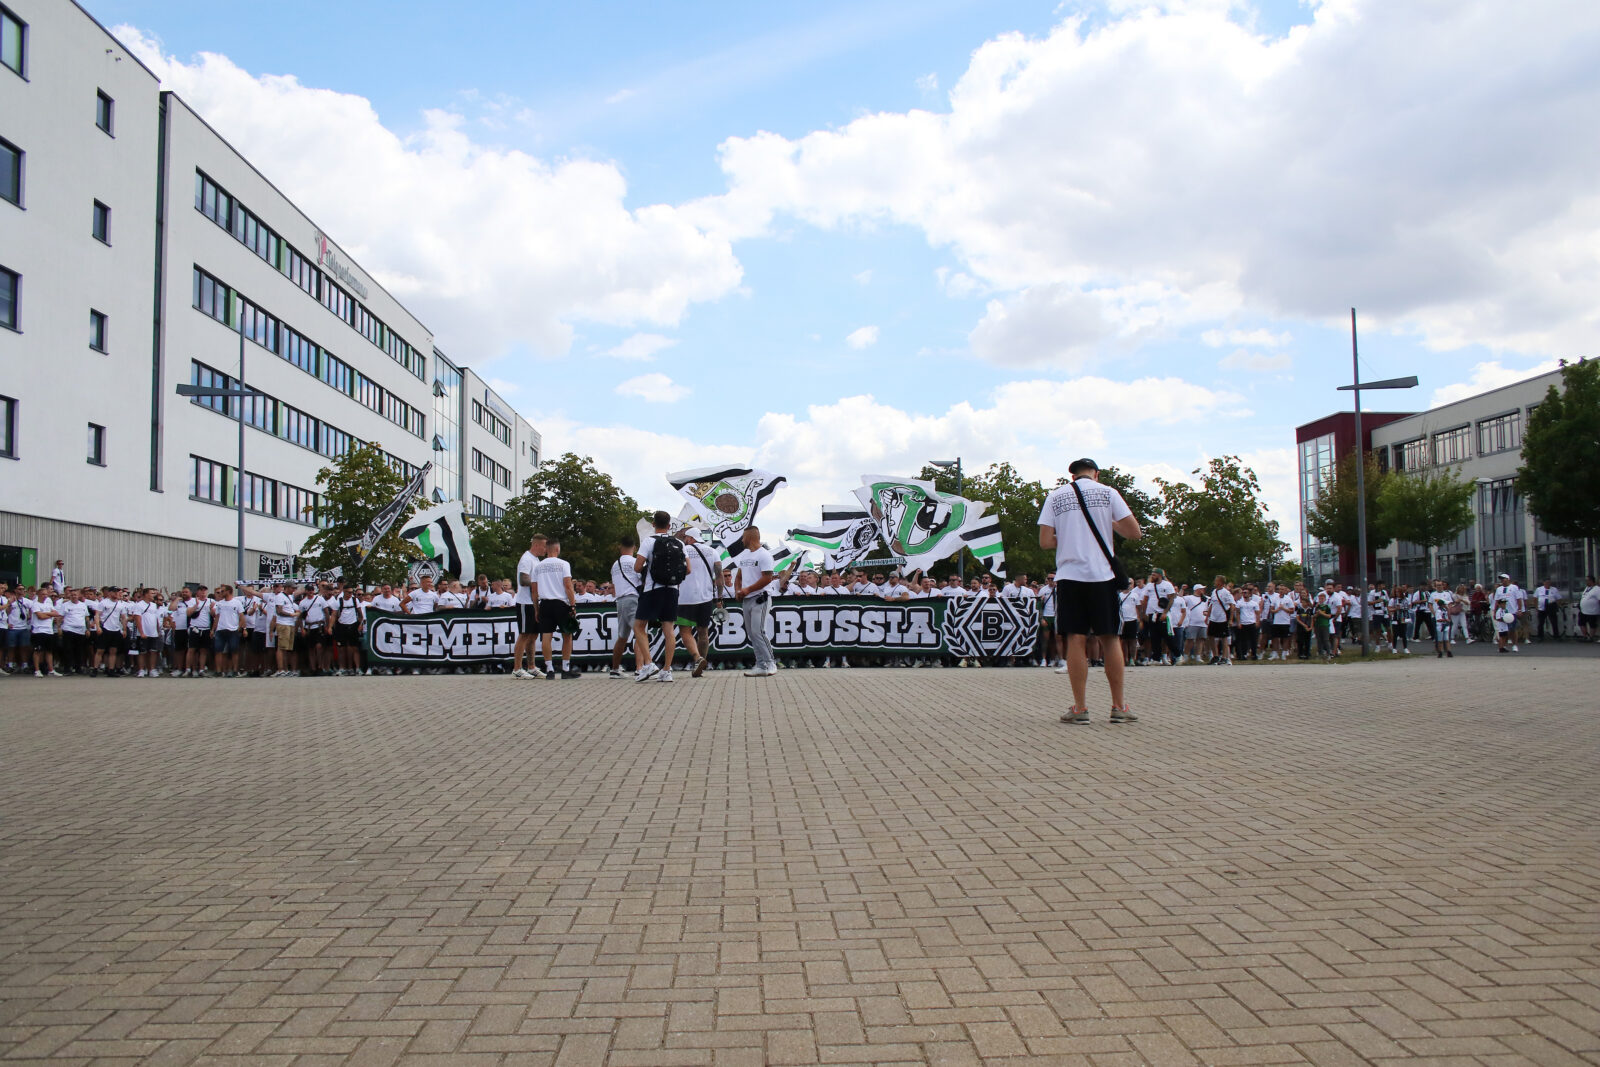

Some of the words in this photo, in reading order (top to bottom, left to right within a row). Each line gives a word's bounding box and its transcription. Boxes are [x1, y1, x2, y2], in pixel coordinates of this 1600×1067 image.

[29, 553, 34, 564] 8
[260, 555, 296, 566] SALARY
[269, 565, 288, 575] CAP
[980, 610, 1005, 642] B
